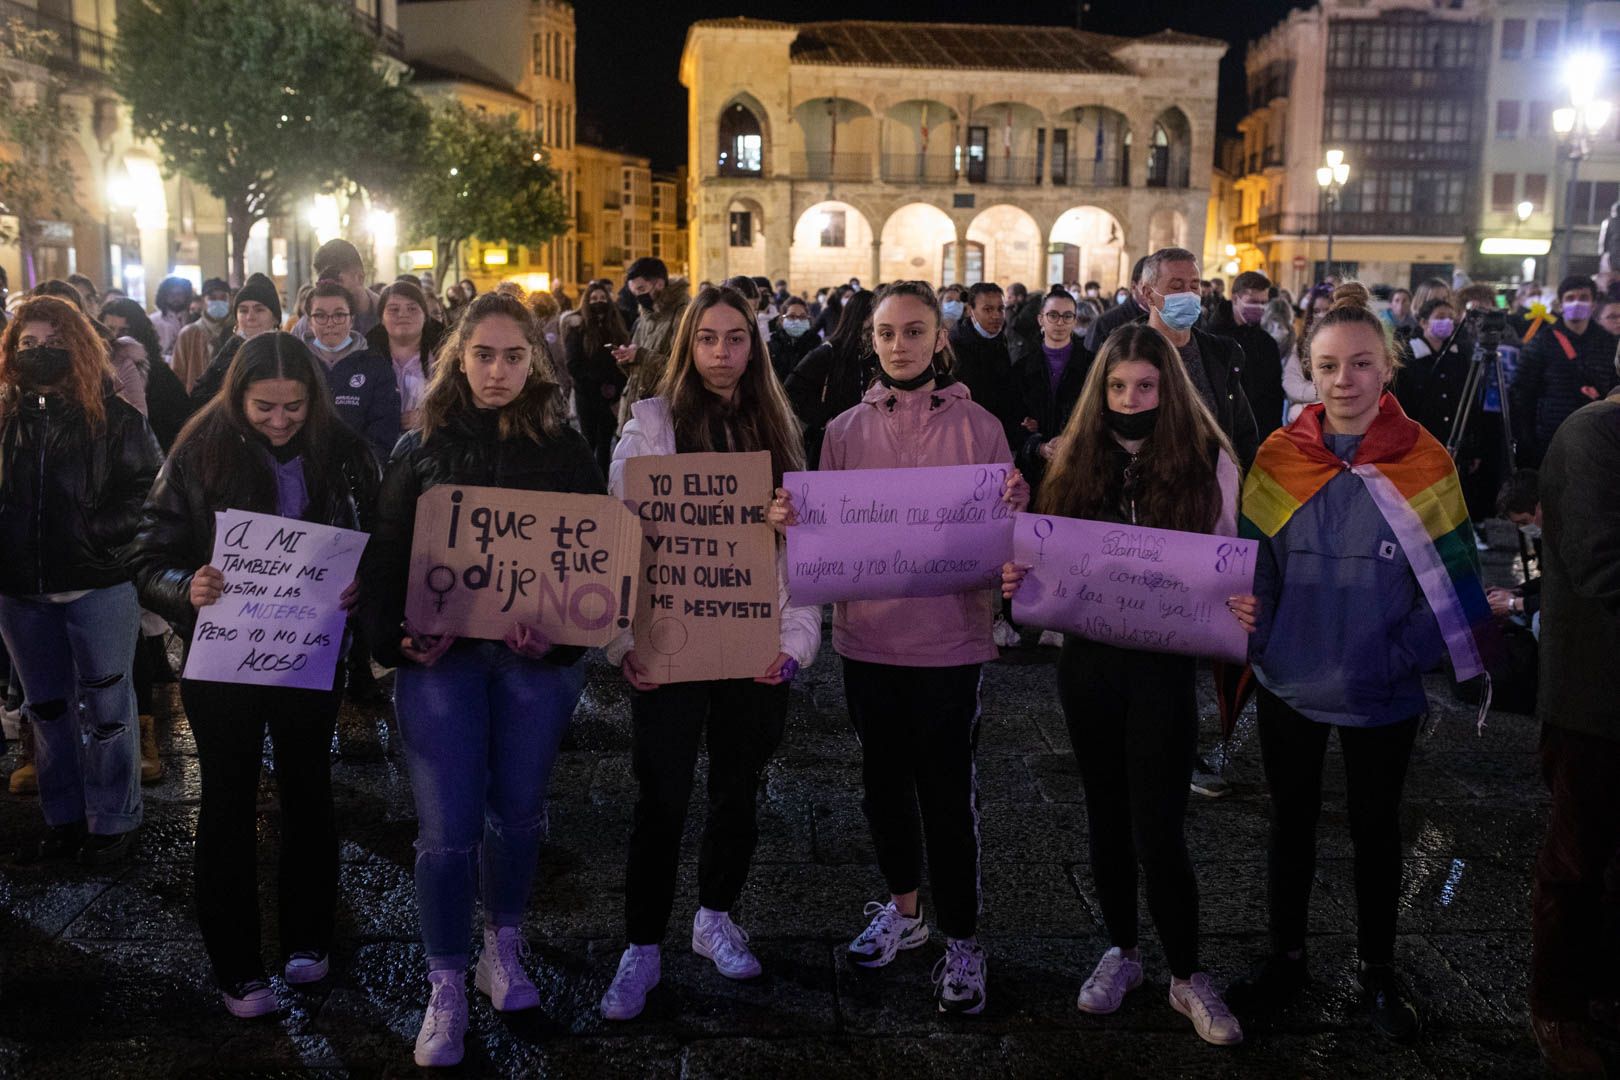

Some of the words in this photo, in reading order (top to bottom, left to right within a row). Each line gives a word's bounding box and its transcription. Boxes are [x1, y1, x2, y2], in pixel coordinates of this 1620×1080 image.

[648, 474, 672, 496] YO
[683, 473, 738, 496] ELIJO
[638, 501, 675, 522] CON
[680, 500, 734, 526] QUIÉN
[740, 505, 766, 525] ME
[907, 507, 929, 523] me
[936, 499, 986, 532] gustan
[266, 528, 307, 553] MI
[551, 516, 597, 550] te
[645, 535, 718, 557] VISTO
[726, 541, 738, 557] Y
[795, 556, 845, 584] mujeres
[853, 559, 867, 583] y
[868, 559, 887, 576] no
[893, 550, 922, 575] las
[1069, 553, 1092, 577] el
[1215, 542, 1248, 576] 8M
[296, 566, 328, 582] ME
[463, 554, 537, 613] dije
[551, 549, 609, 583] que
[646, 564, 686, 586] CON
[694, 563, 751, 588] QUIÉN
[222, 581, 268, 597] USTAN
[274, 586, 301, 599] LAS
[1052, 580, 1069, 599] de
[1077, 584, 1103, 604] las
[238, 601, 318, 620] MUJERES
[650, 594, 674, 609] ME
[684, 599, 772, 619] DESVISTO
[197, 622, 238, 642] PERO
[248, 628, 266, 643] YO
[273, 629, 297, 644] NO
[302, 632, 331, 647] LAS
[236, 648, 308, 672] ACOSO
